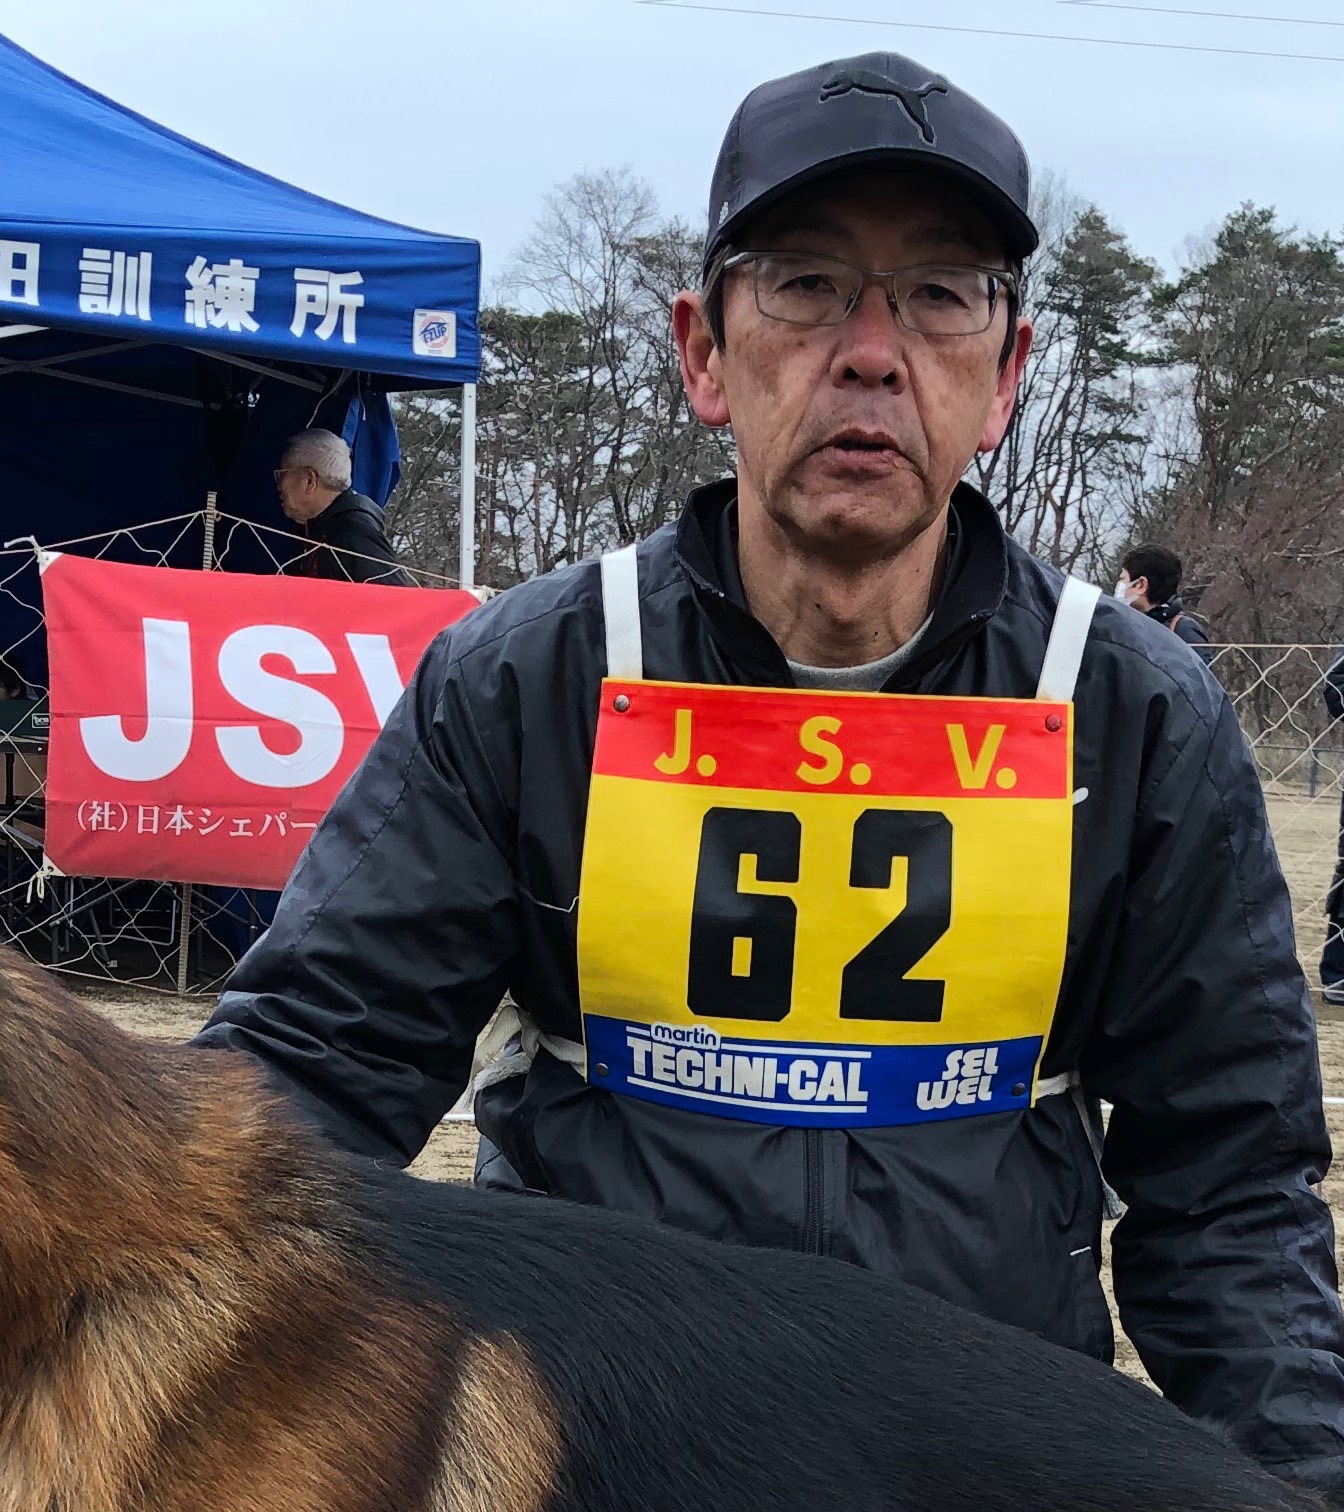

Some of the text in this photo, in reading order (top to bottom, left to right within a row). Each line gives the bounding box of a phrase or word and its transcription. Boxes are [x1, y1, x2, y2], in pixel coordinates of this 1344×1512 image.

[653, 708, 1017, 790] J. S. V.
[686, 806, 953, 1023] 62
[654, 1026, 718, 1048] martin
[626, 1036, 868, 1102] TECHNI-CAL
[942, 1047, 999, 1082] SEL
[916, 1075, 993, 1111] WEL
